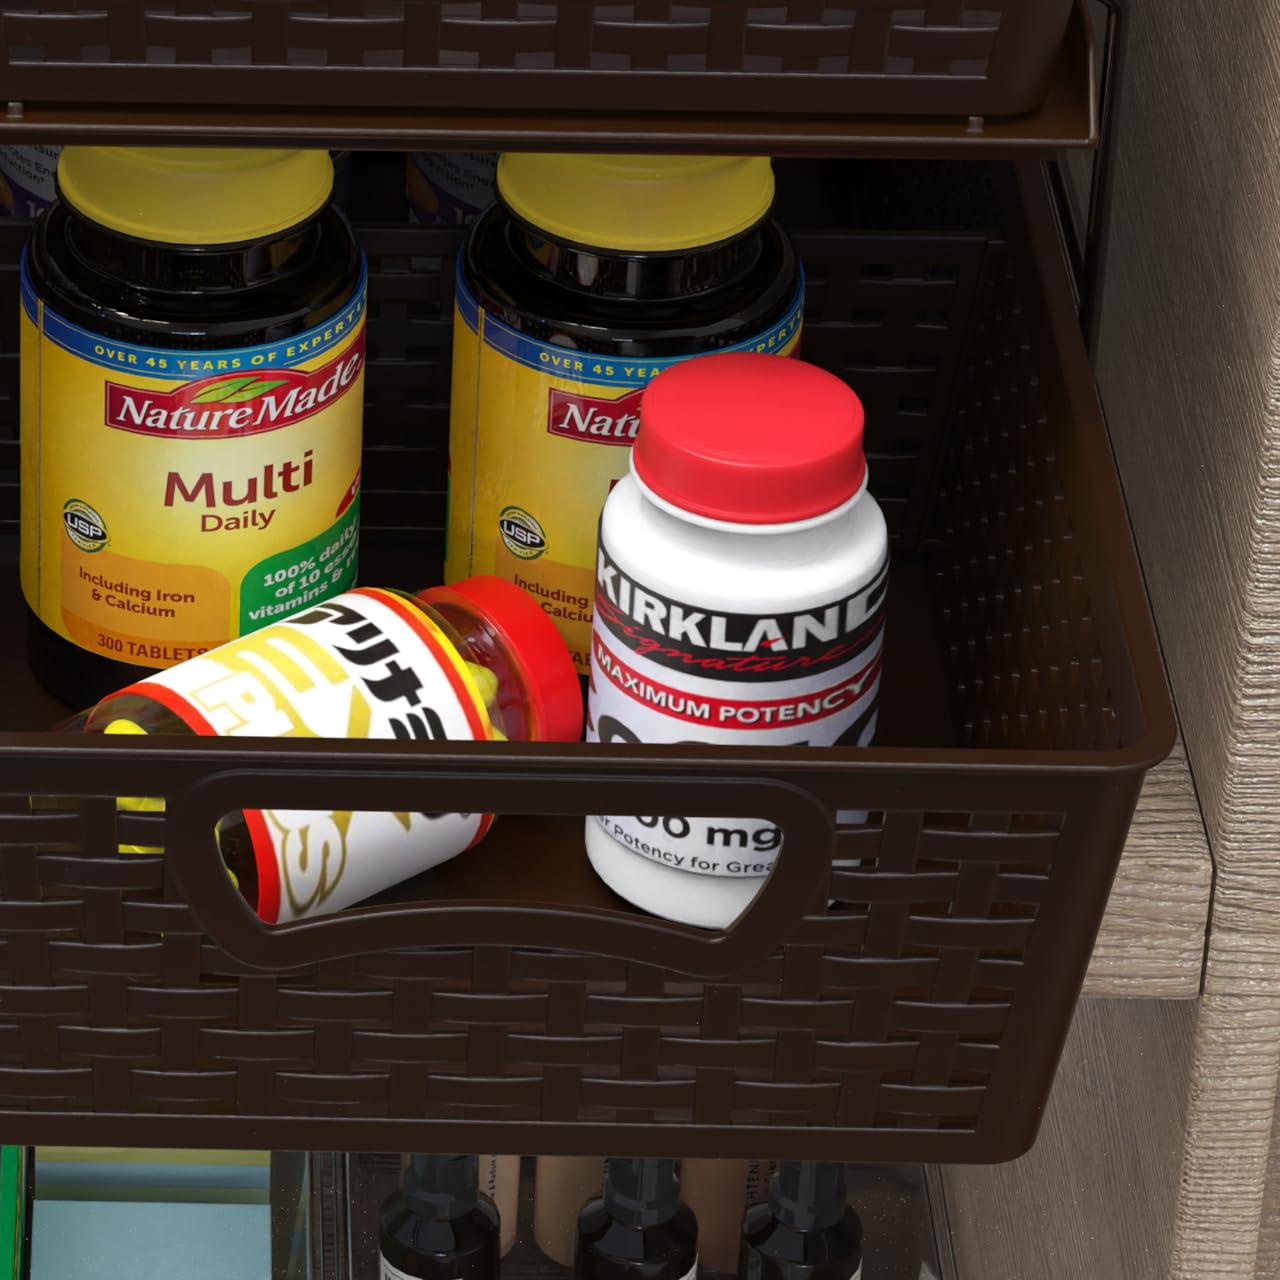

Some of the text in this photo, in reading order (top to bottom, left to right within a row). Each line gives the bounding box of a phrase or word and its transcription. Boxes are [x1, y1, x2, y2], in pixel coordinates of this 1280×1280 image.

[94, 345, 138, 365] OVER
[145, 357, 168, 369] 45
[176, 358, 242, 371] YEARS
[251, 351, 277, 366] OF
[539, 351, 584, 372] OVER
[592, 363, 614, 376] 45
[624, 366, 667, 378] YEA
[164, 449, 314, 509] Multi
[67, 513, 103, 538] USP
[200, 508, 277, 534] Daily
[503, 520, 541, 545] USP
[79, 565, 196, 604] Including Iron
[263, 556, 316, 587] 100%
[274, 569, 321, 598] of 10
[91, 588, 176, 618] & Calcium
[248, 579, 329, 620] vitamins
[97, 633, 123, 652] 300
[596, 643, 878, 724] MAXIMUM POTENCY
[613, 824, 685, 866] Potency
[690, 856, 720, 872] for
[706, 826, 782, 852] mg
